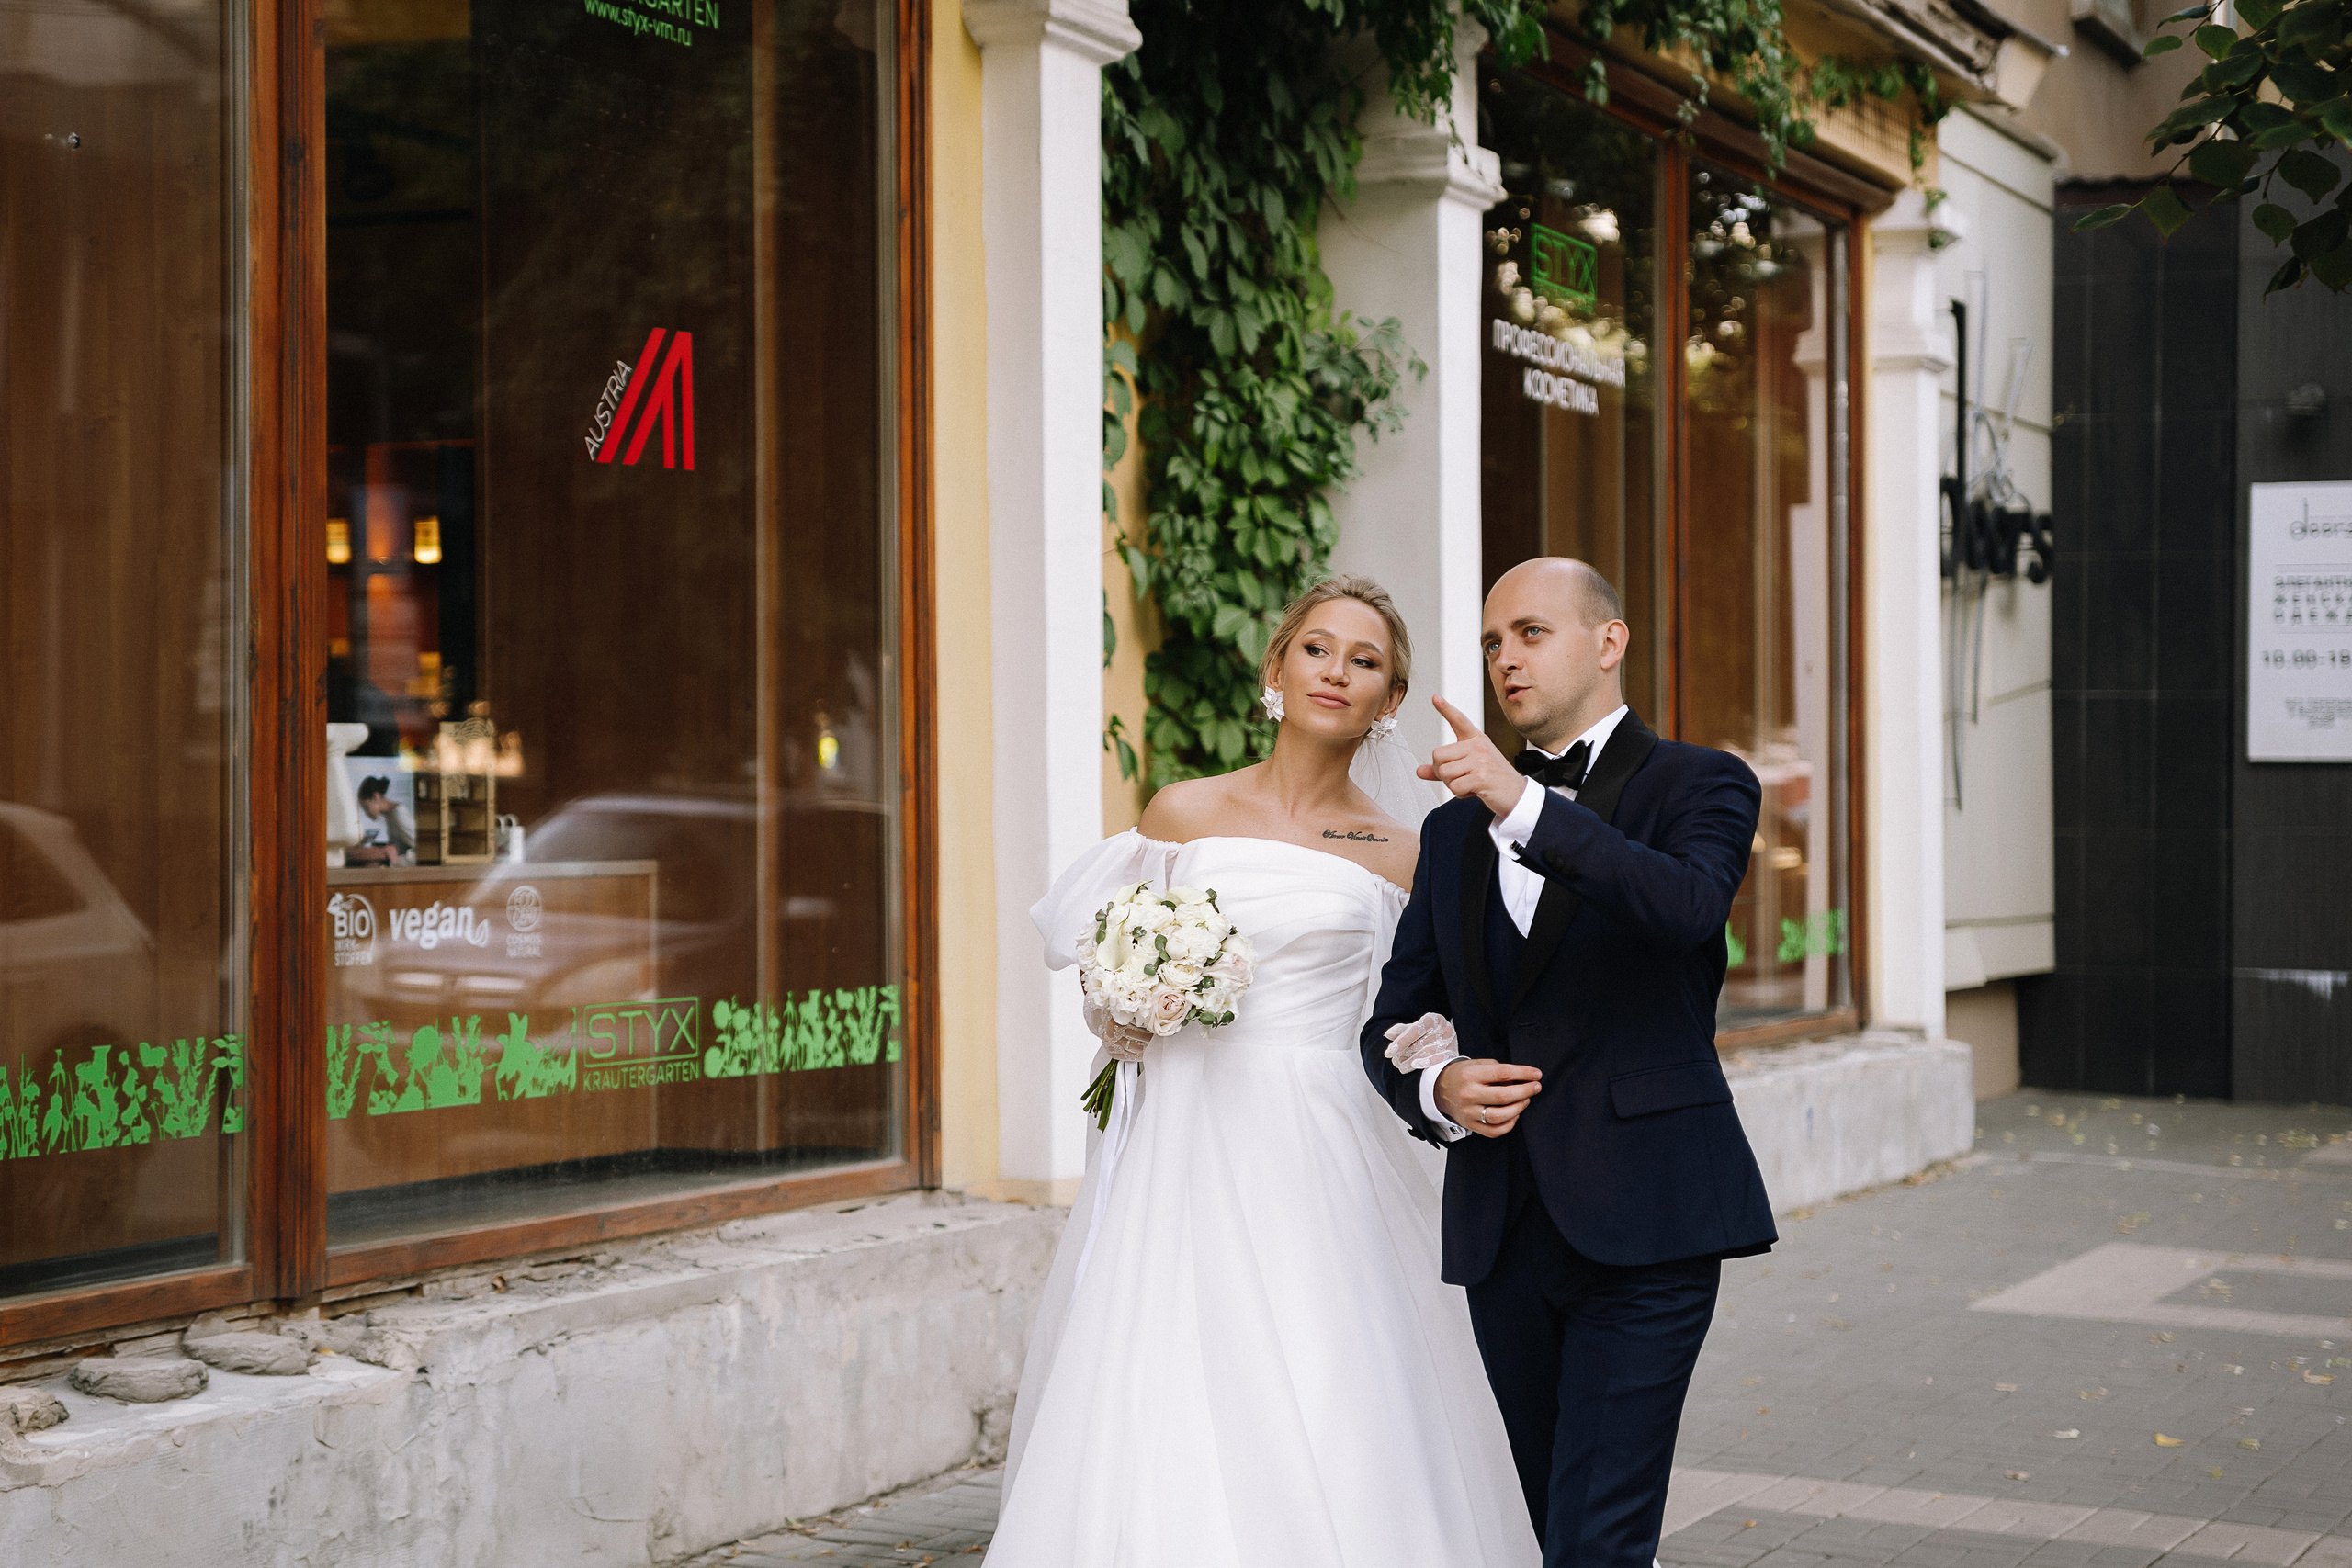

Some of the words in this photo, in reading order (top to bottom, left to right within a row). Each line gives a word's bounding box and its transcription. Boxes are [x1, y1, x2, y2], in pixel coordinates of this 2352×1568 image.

[584, 0, 692, 46] www.styx-vm.ru
[1535, 233, 1596, 299] STYX
[584, 359, 632, 461] AUSTRIA
[334, 909, 370, 938] BIO
[389, 900, 489, 950] vegan
[589, 1006, 695, 1059] STYX
